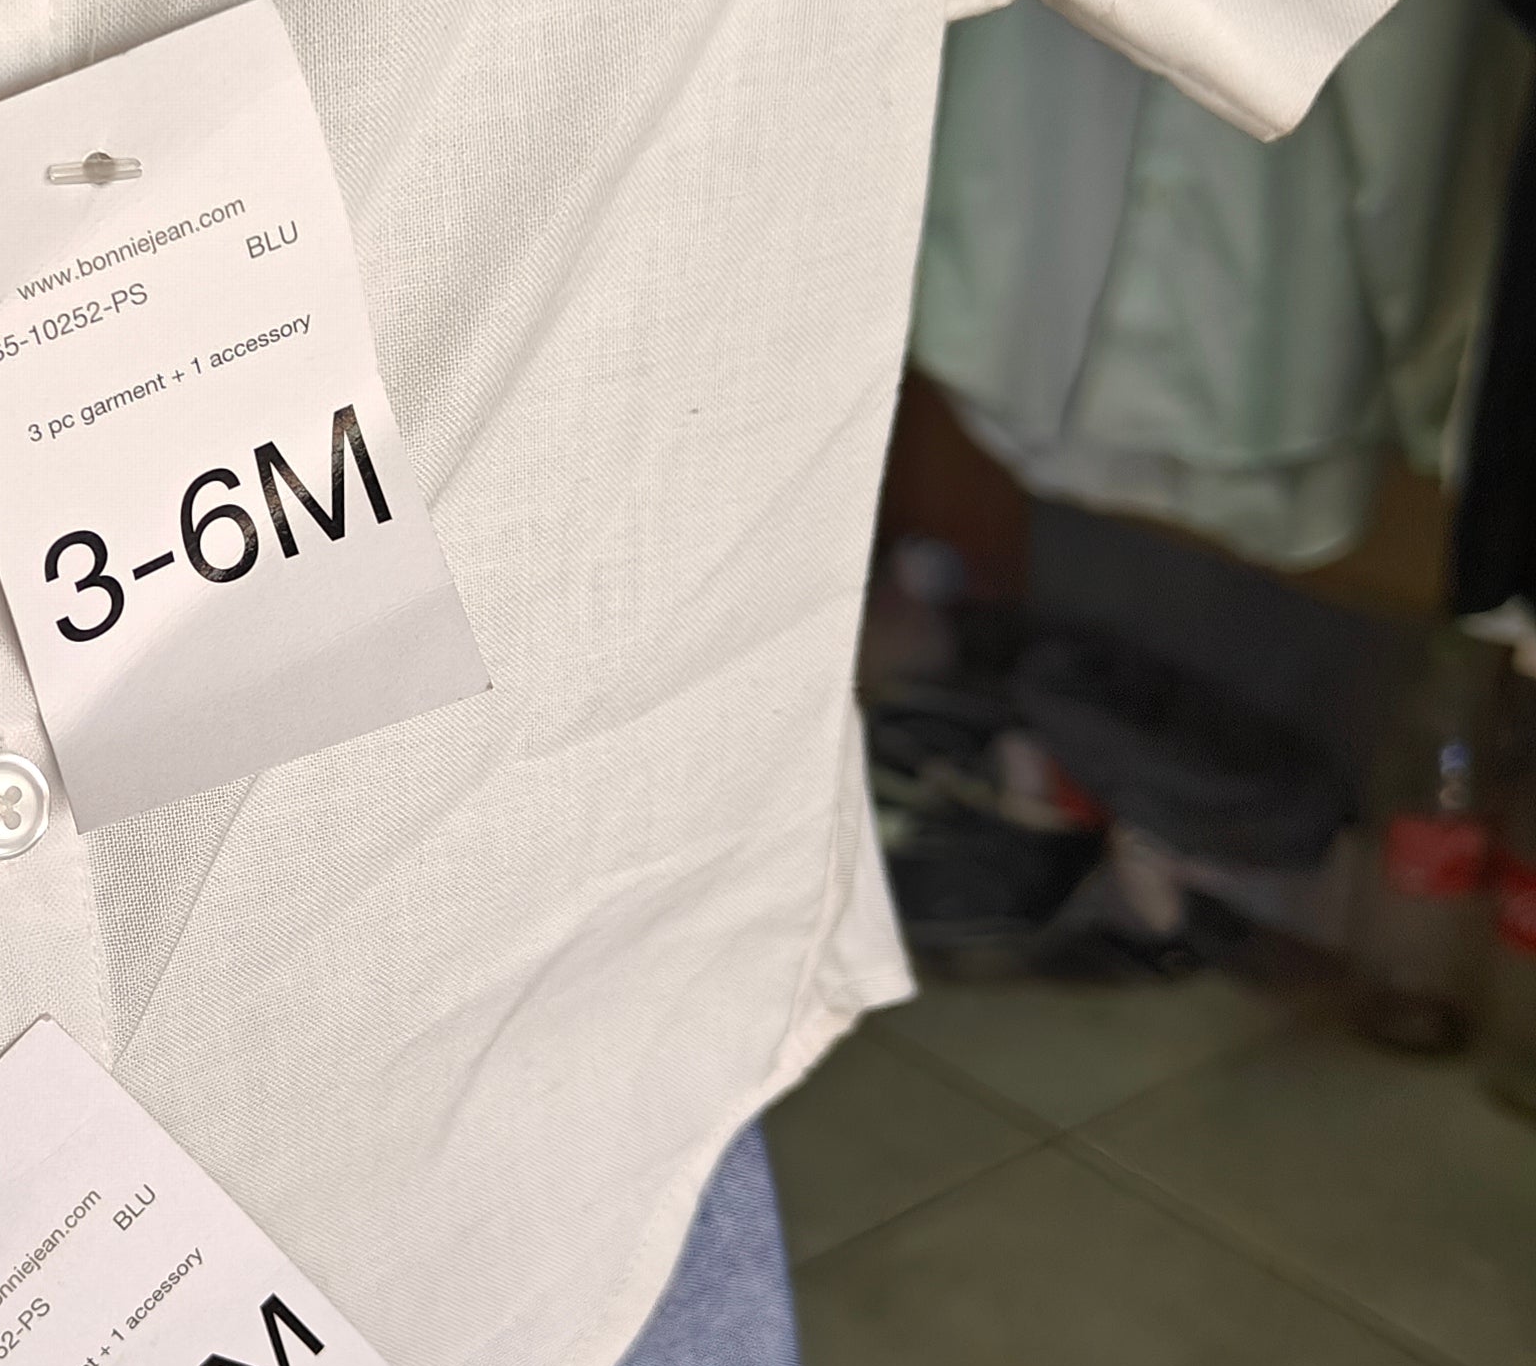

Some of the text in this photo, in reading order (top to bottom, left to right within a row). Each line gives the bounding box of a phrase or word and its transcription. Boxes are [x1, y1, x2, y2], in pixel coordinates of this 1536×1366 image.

[16, 198, 246, 301] www.bonniejean.com
[245, 219, 299, 260] BLU
[27, 313, 311, 443] 3 pc garment + 1 accessory
[44, 404, 393, 643] 3-6M
[112, 1183, 156, 1232] BLU
[100, 1345, 111, 1357] +
[110, 1328, 125, 1342] 1
[125, 1246, 203, 1331] accessory
